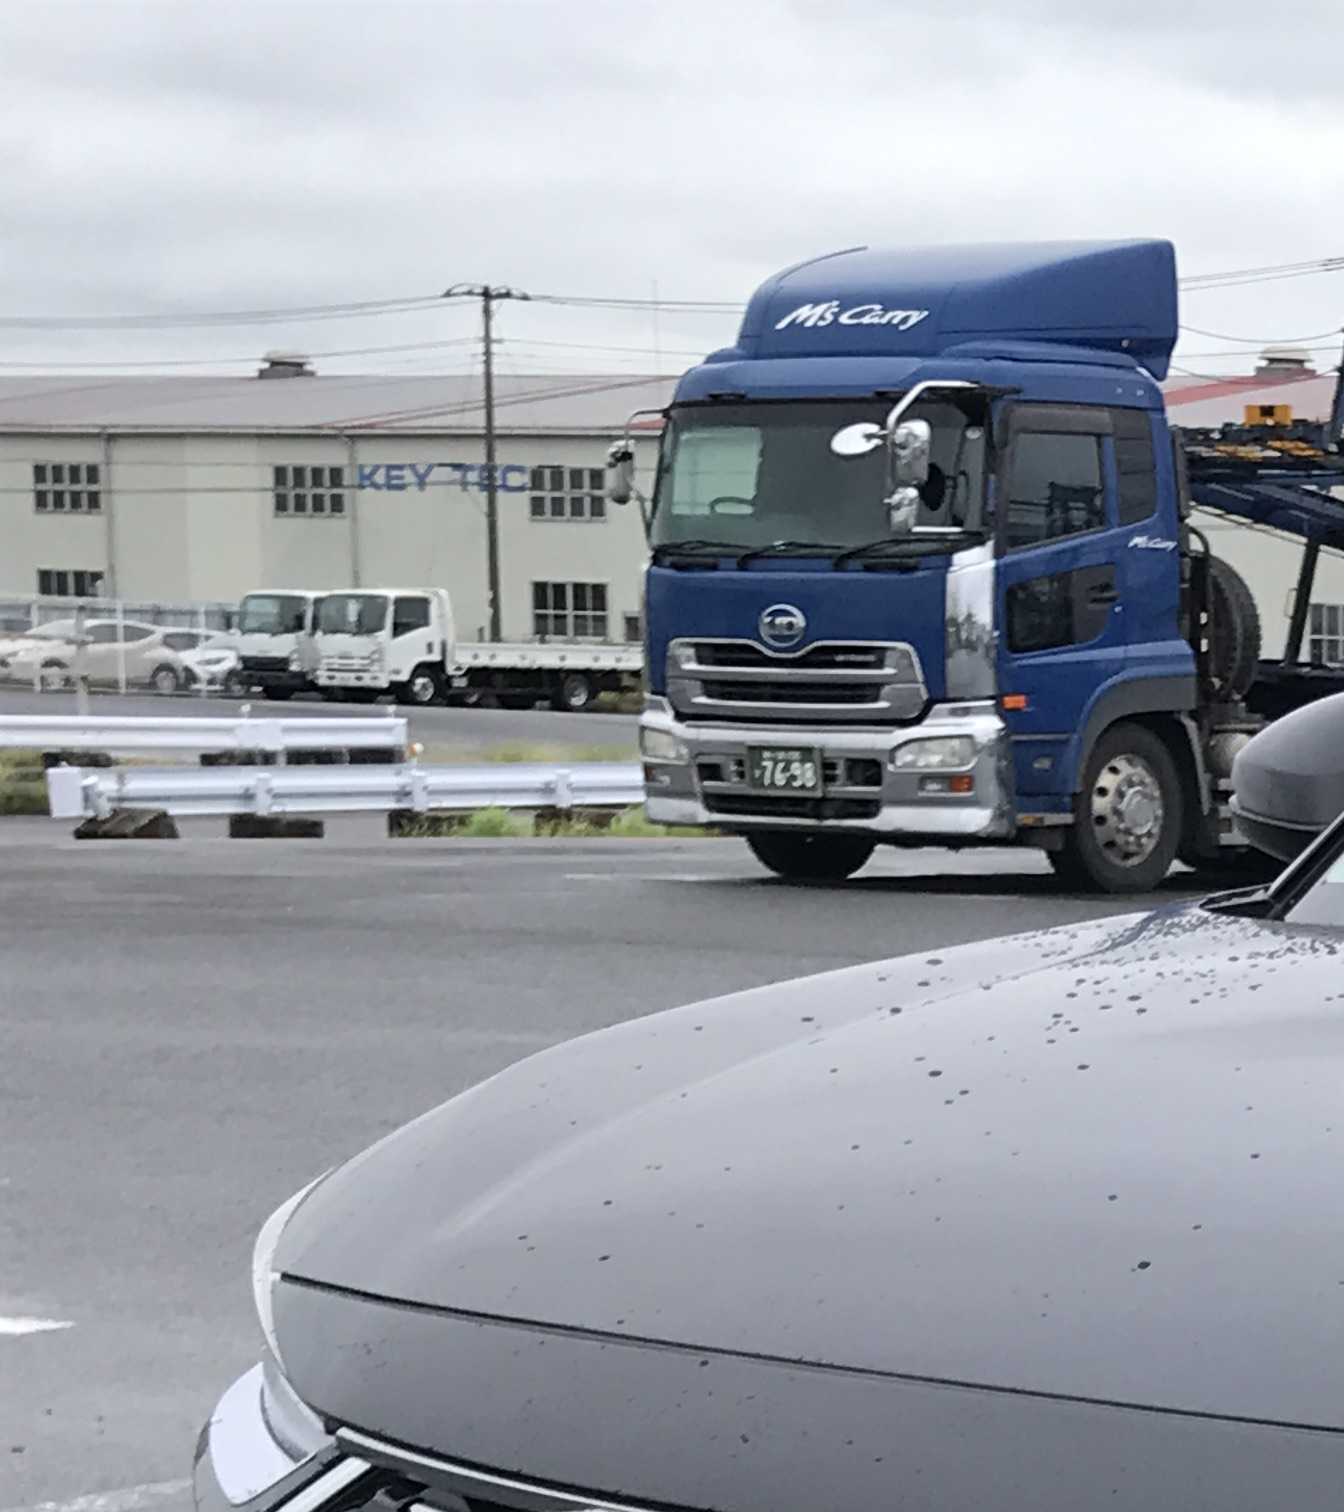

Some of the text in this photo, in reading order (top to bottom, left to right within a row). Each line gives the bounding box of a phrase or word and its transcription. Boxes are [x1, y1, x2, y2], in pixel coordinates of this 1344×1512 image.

[774, 300, 929, 330] M's Carry
[358, 463, 434, 491] KEY
